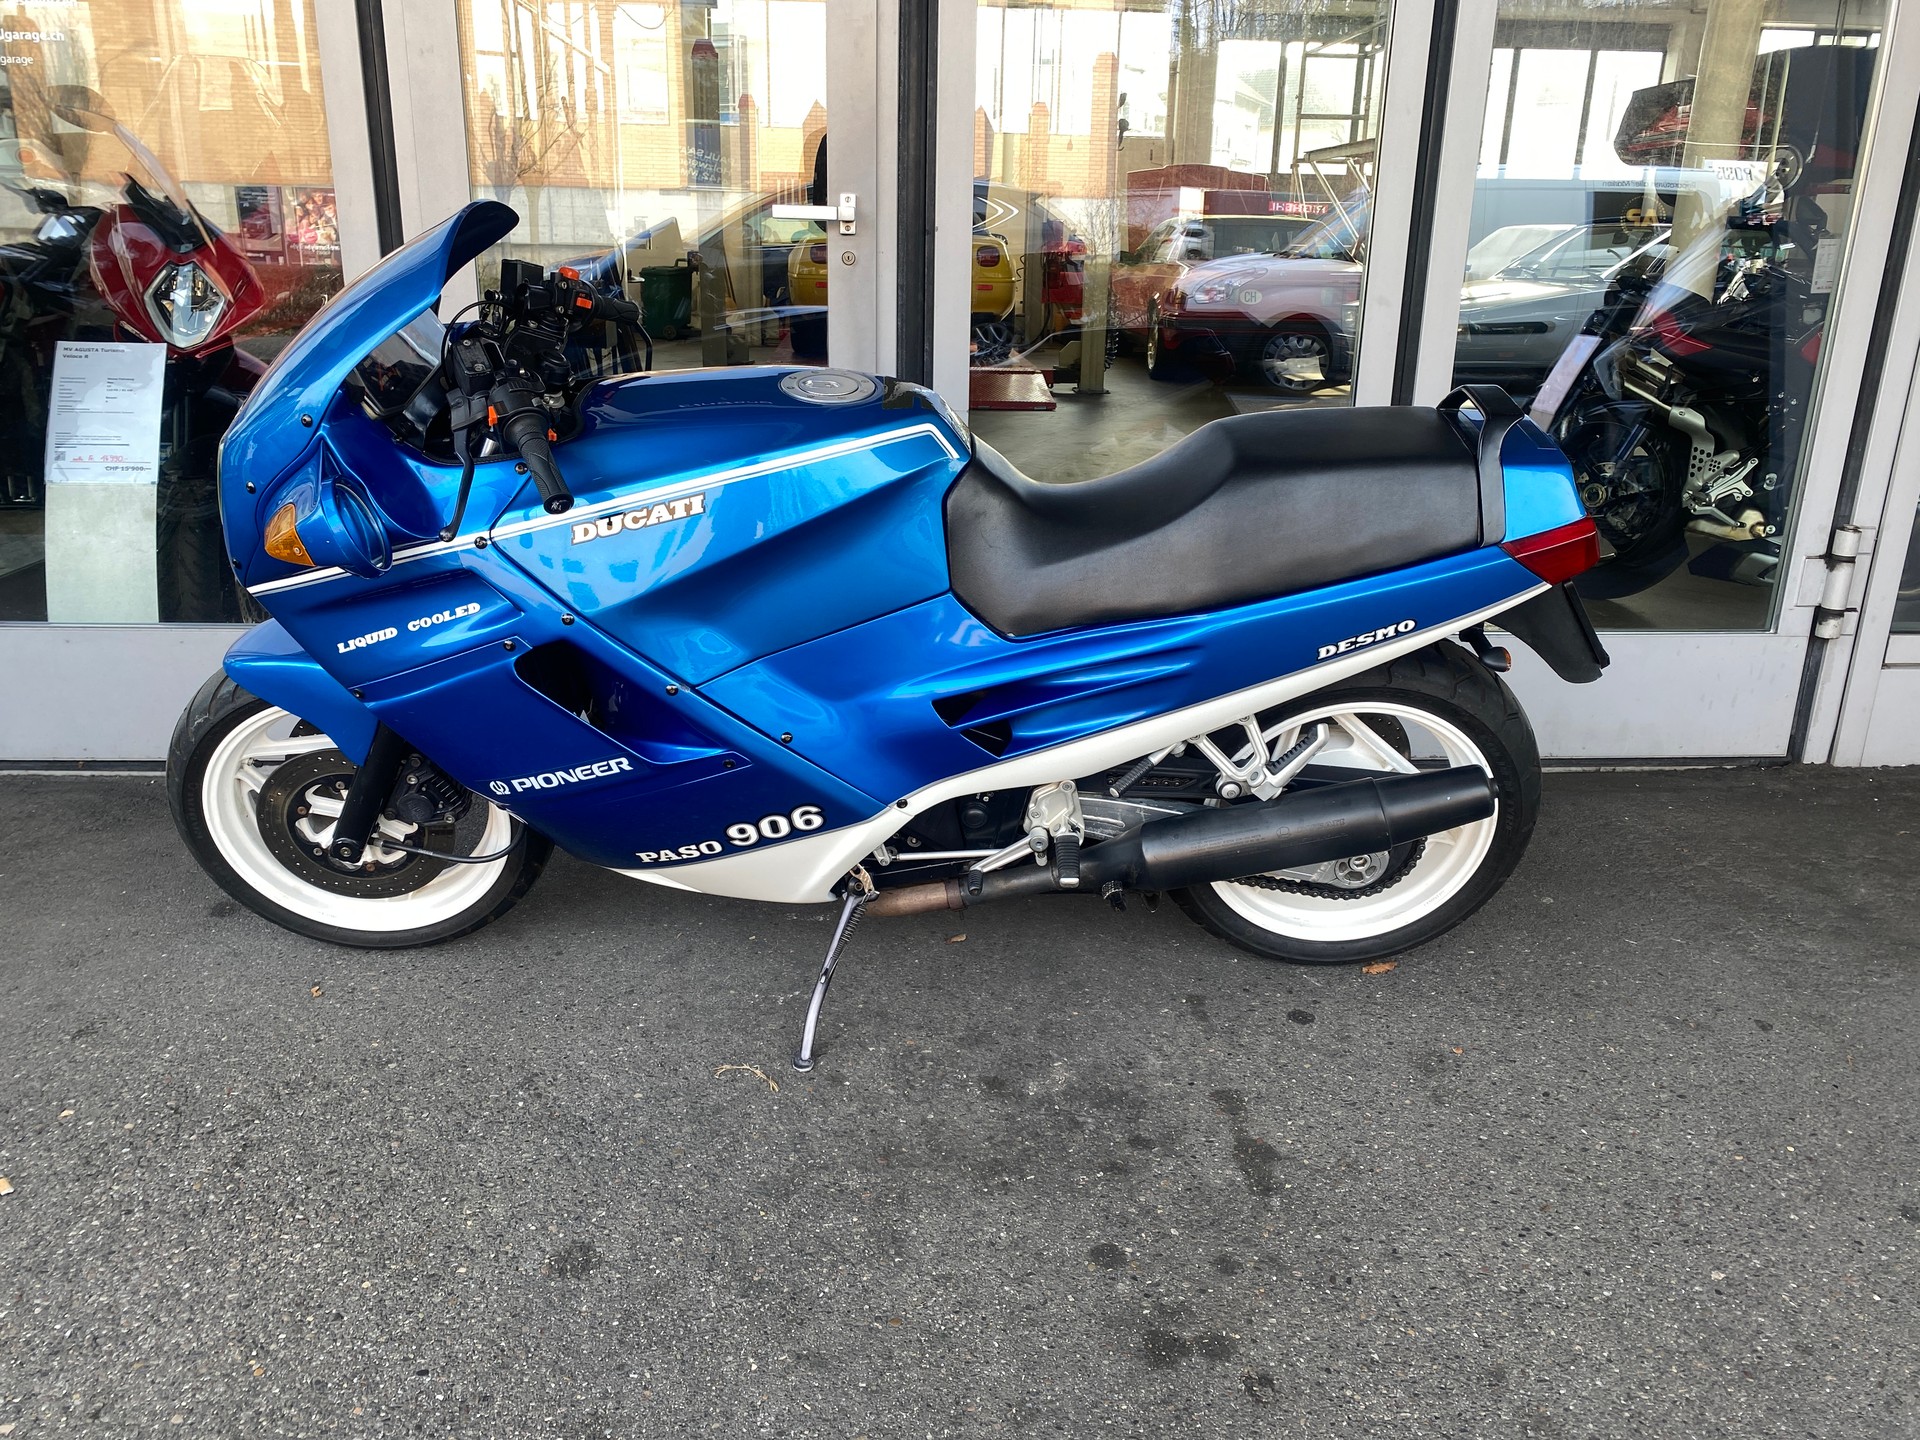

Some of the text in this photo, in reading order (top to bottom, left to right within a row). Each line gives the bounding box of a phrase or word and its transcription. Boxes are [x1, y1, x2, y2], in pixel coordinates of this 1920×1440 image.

[571, 492, 706, 545] DUCATI
[337, 601, 481, 654] LIQUID COOLED
[1317, 619, 1416, 660] DESMO
[511, 756, 634, 793] PIONEER
[635, 804, 825, 863] PASO 906
